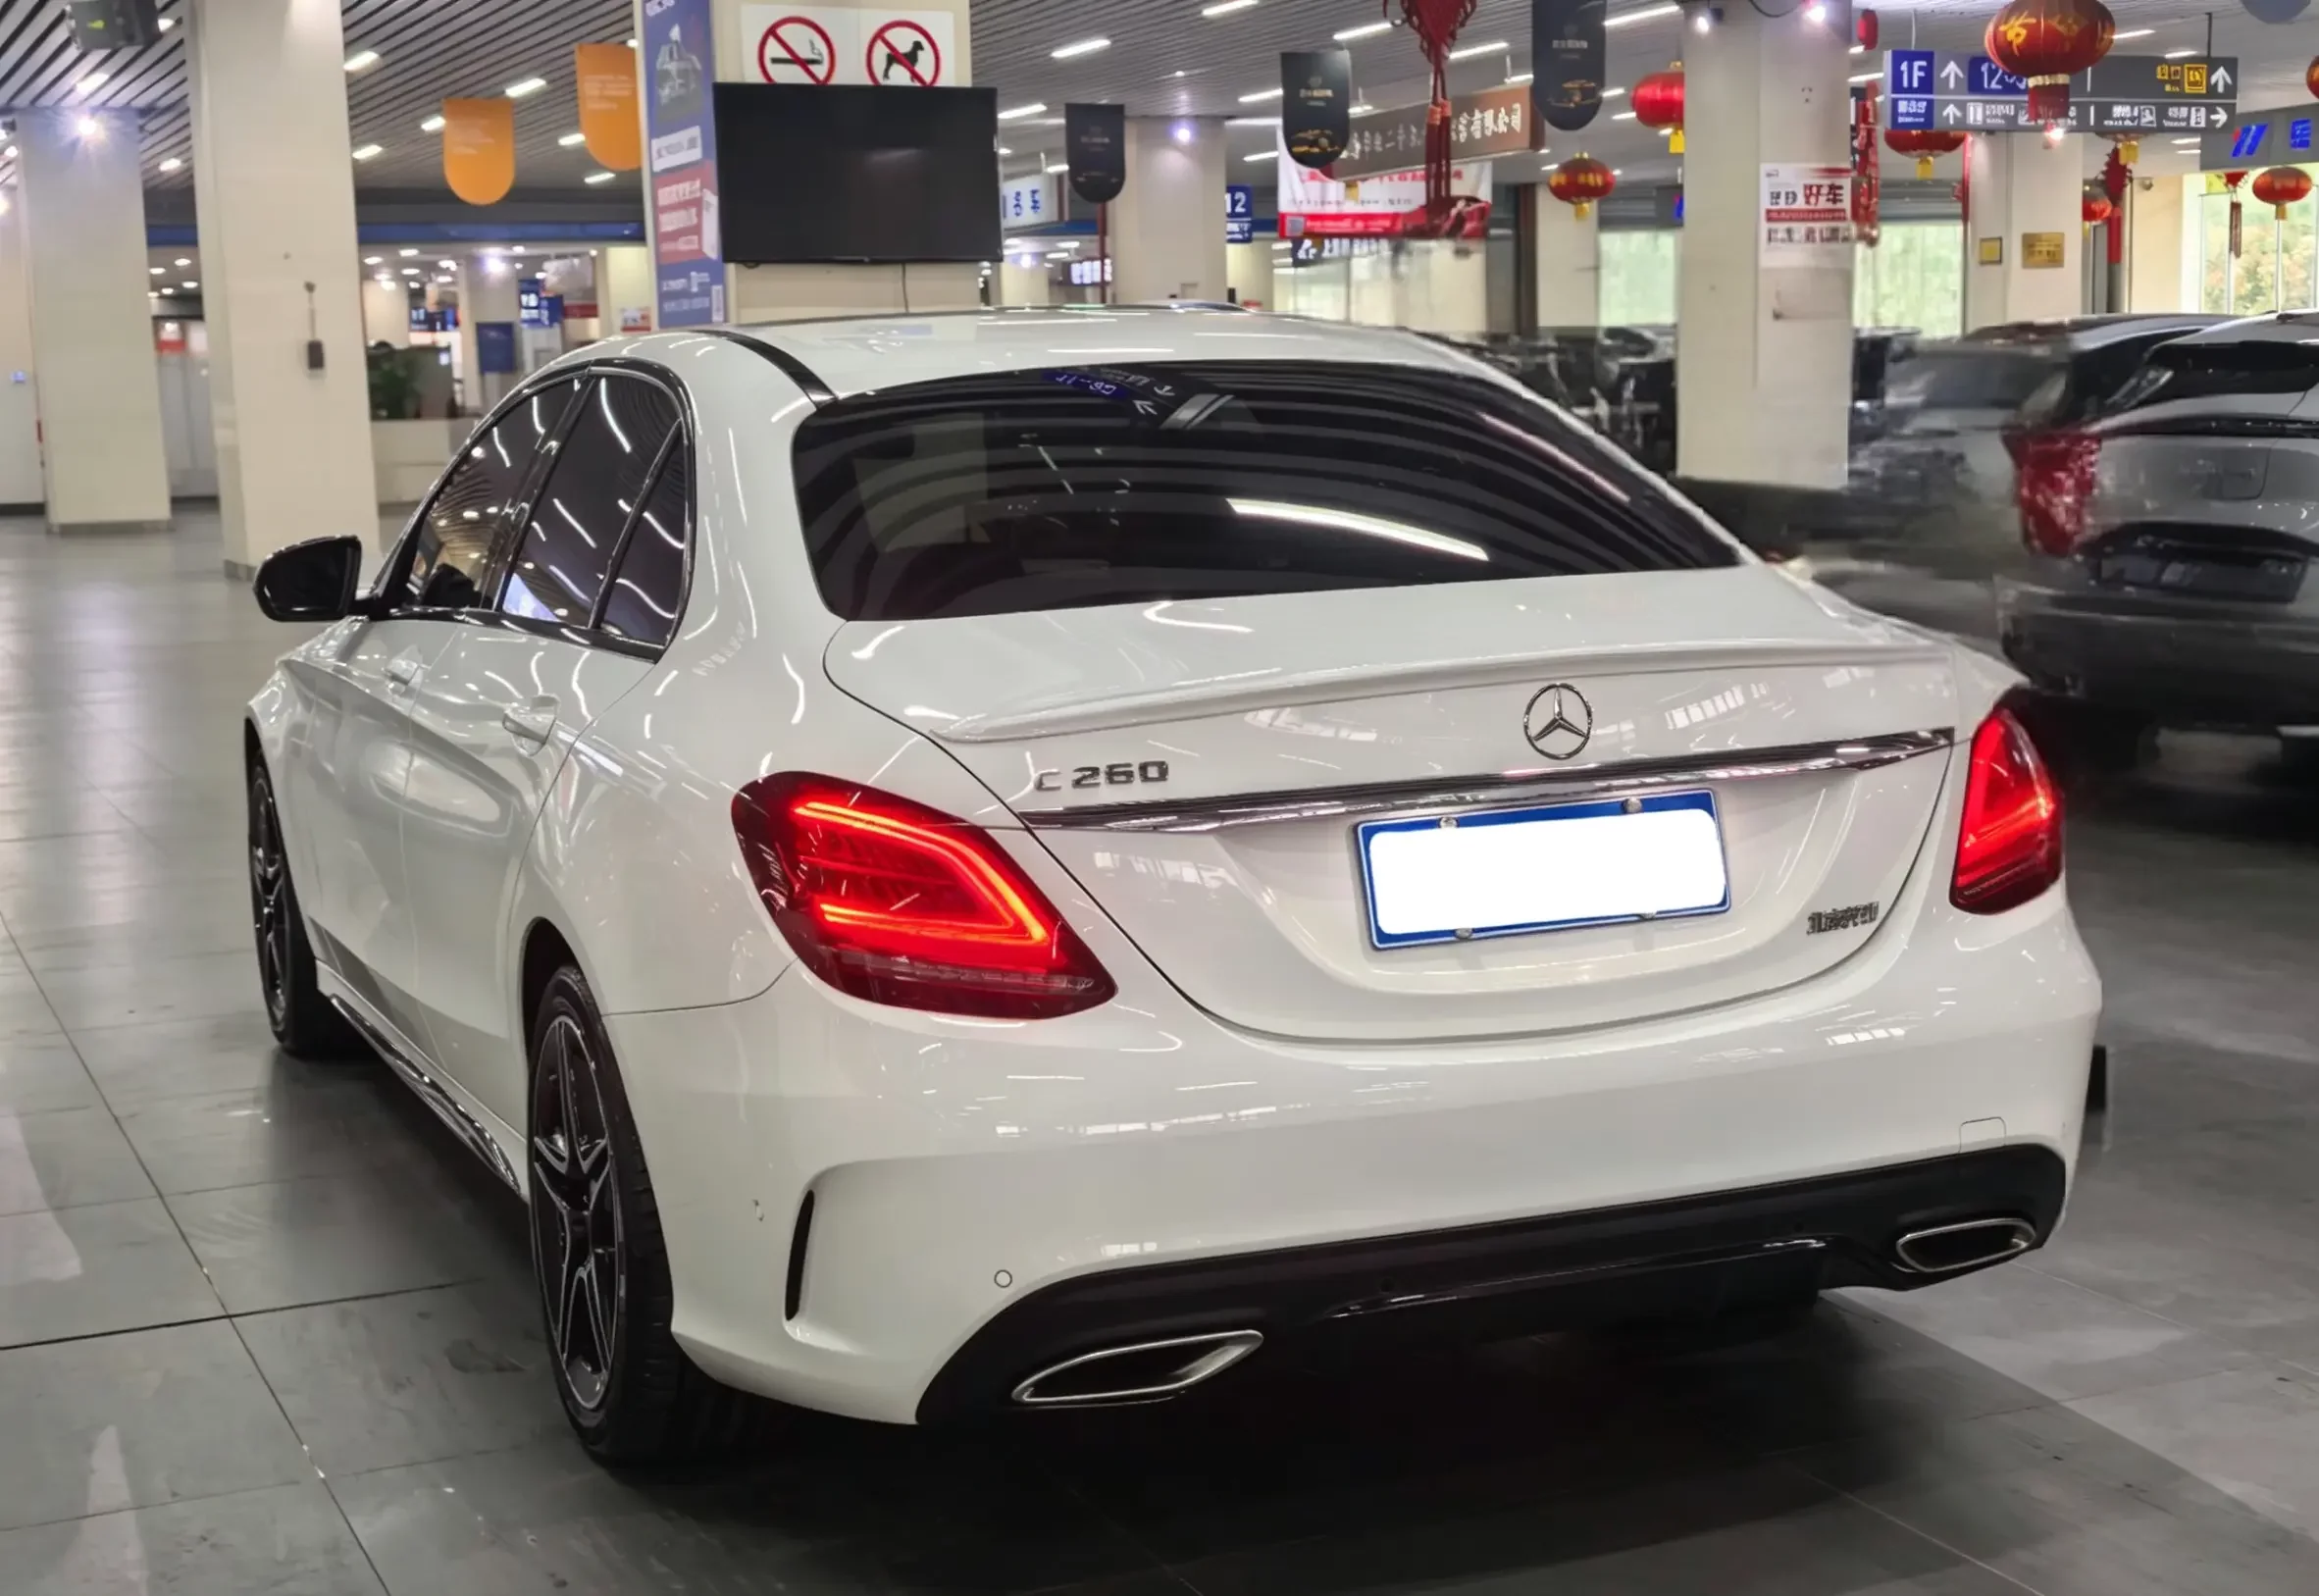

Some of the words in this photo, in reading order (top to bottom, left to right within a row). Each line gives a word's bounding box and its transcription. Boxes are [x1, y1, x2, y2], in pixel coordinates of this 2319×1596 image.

[1900, 60, 1928, 89] 1F
[1225, 191, 1247, 213] 12
[1035, 768, 1062, 792] C
[1071, 760, 1169, 790] 260
